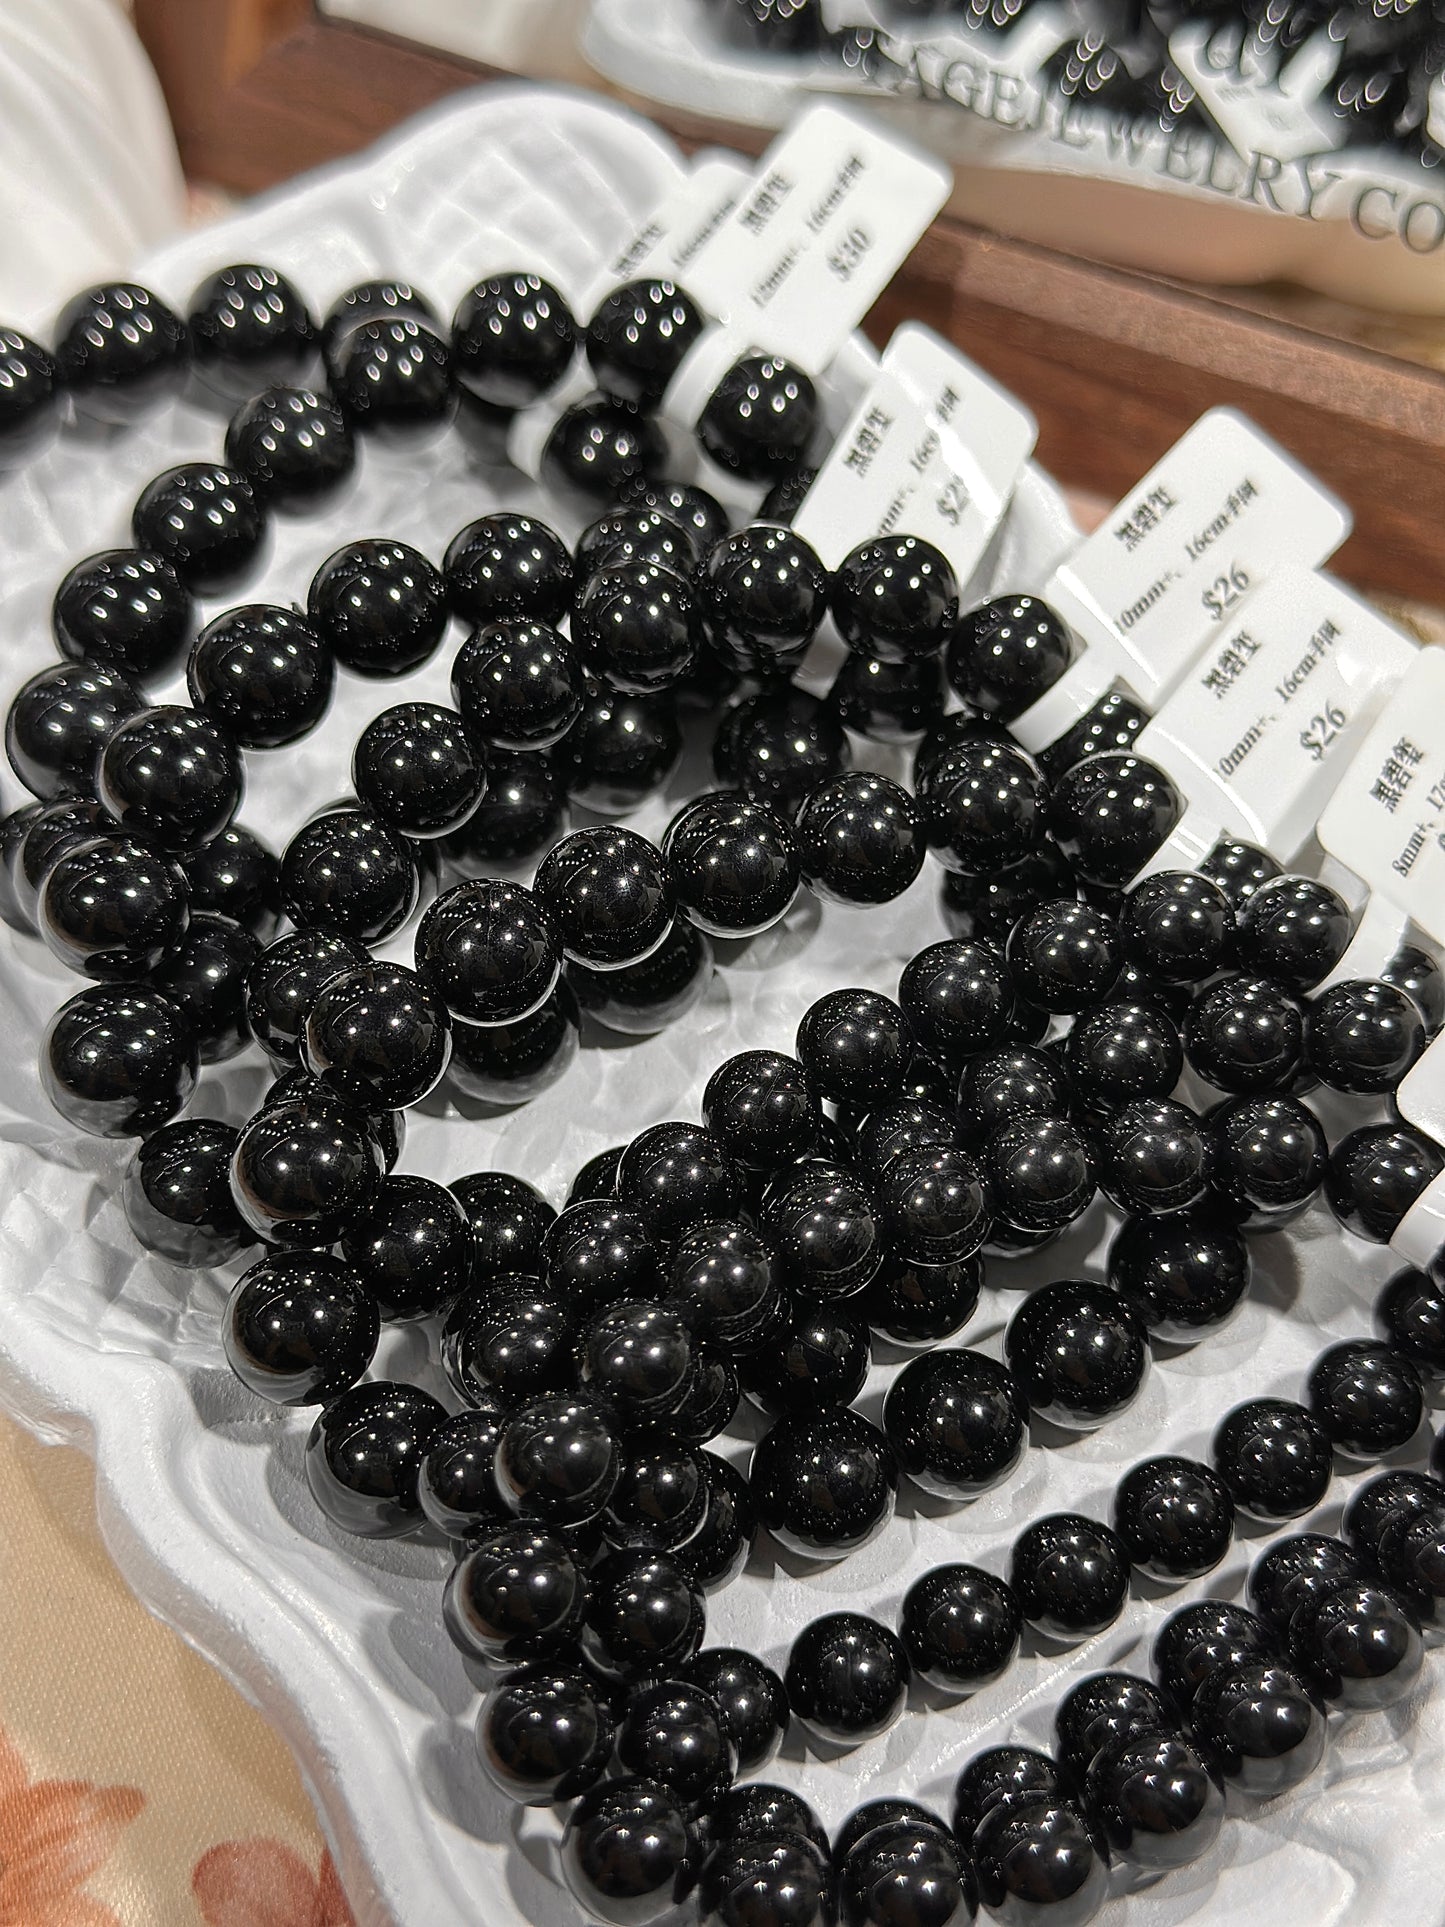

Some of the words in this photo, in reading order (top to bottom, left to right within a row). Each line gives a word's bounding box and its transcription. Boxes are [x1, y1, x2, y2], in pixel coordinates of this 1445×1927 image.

[826, 228, 873, 283] $30
[1201, 560, 1250, 621] $26
[1300, 698, 1347, 761] $26
